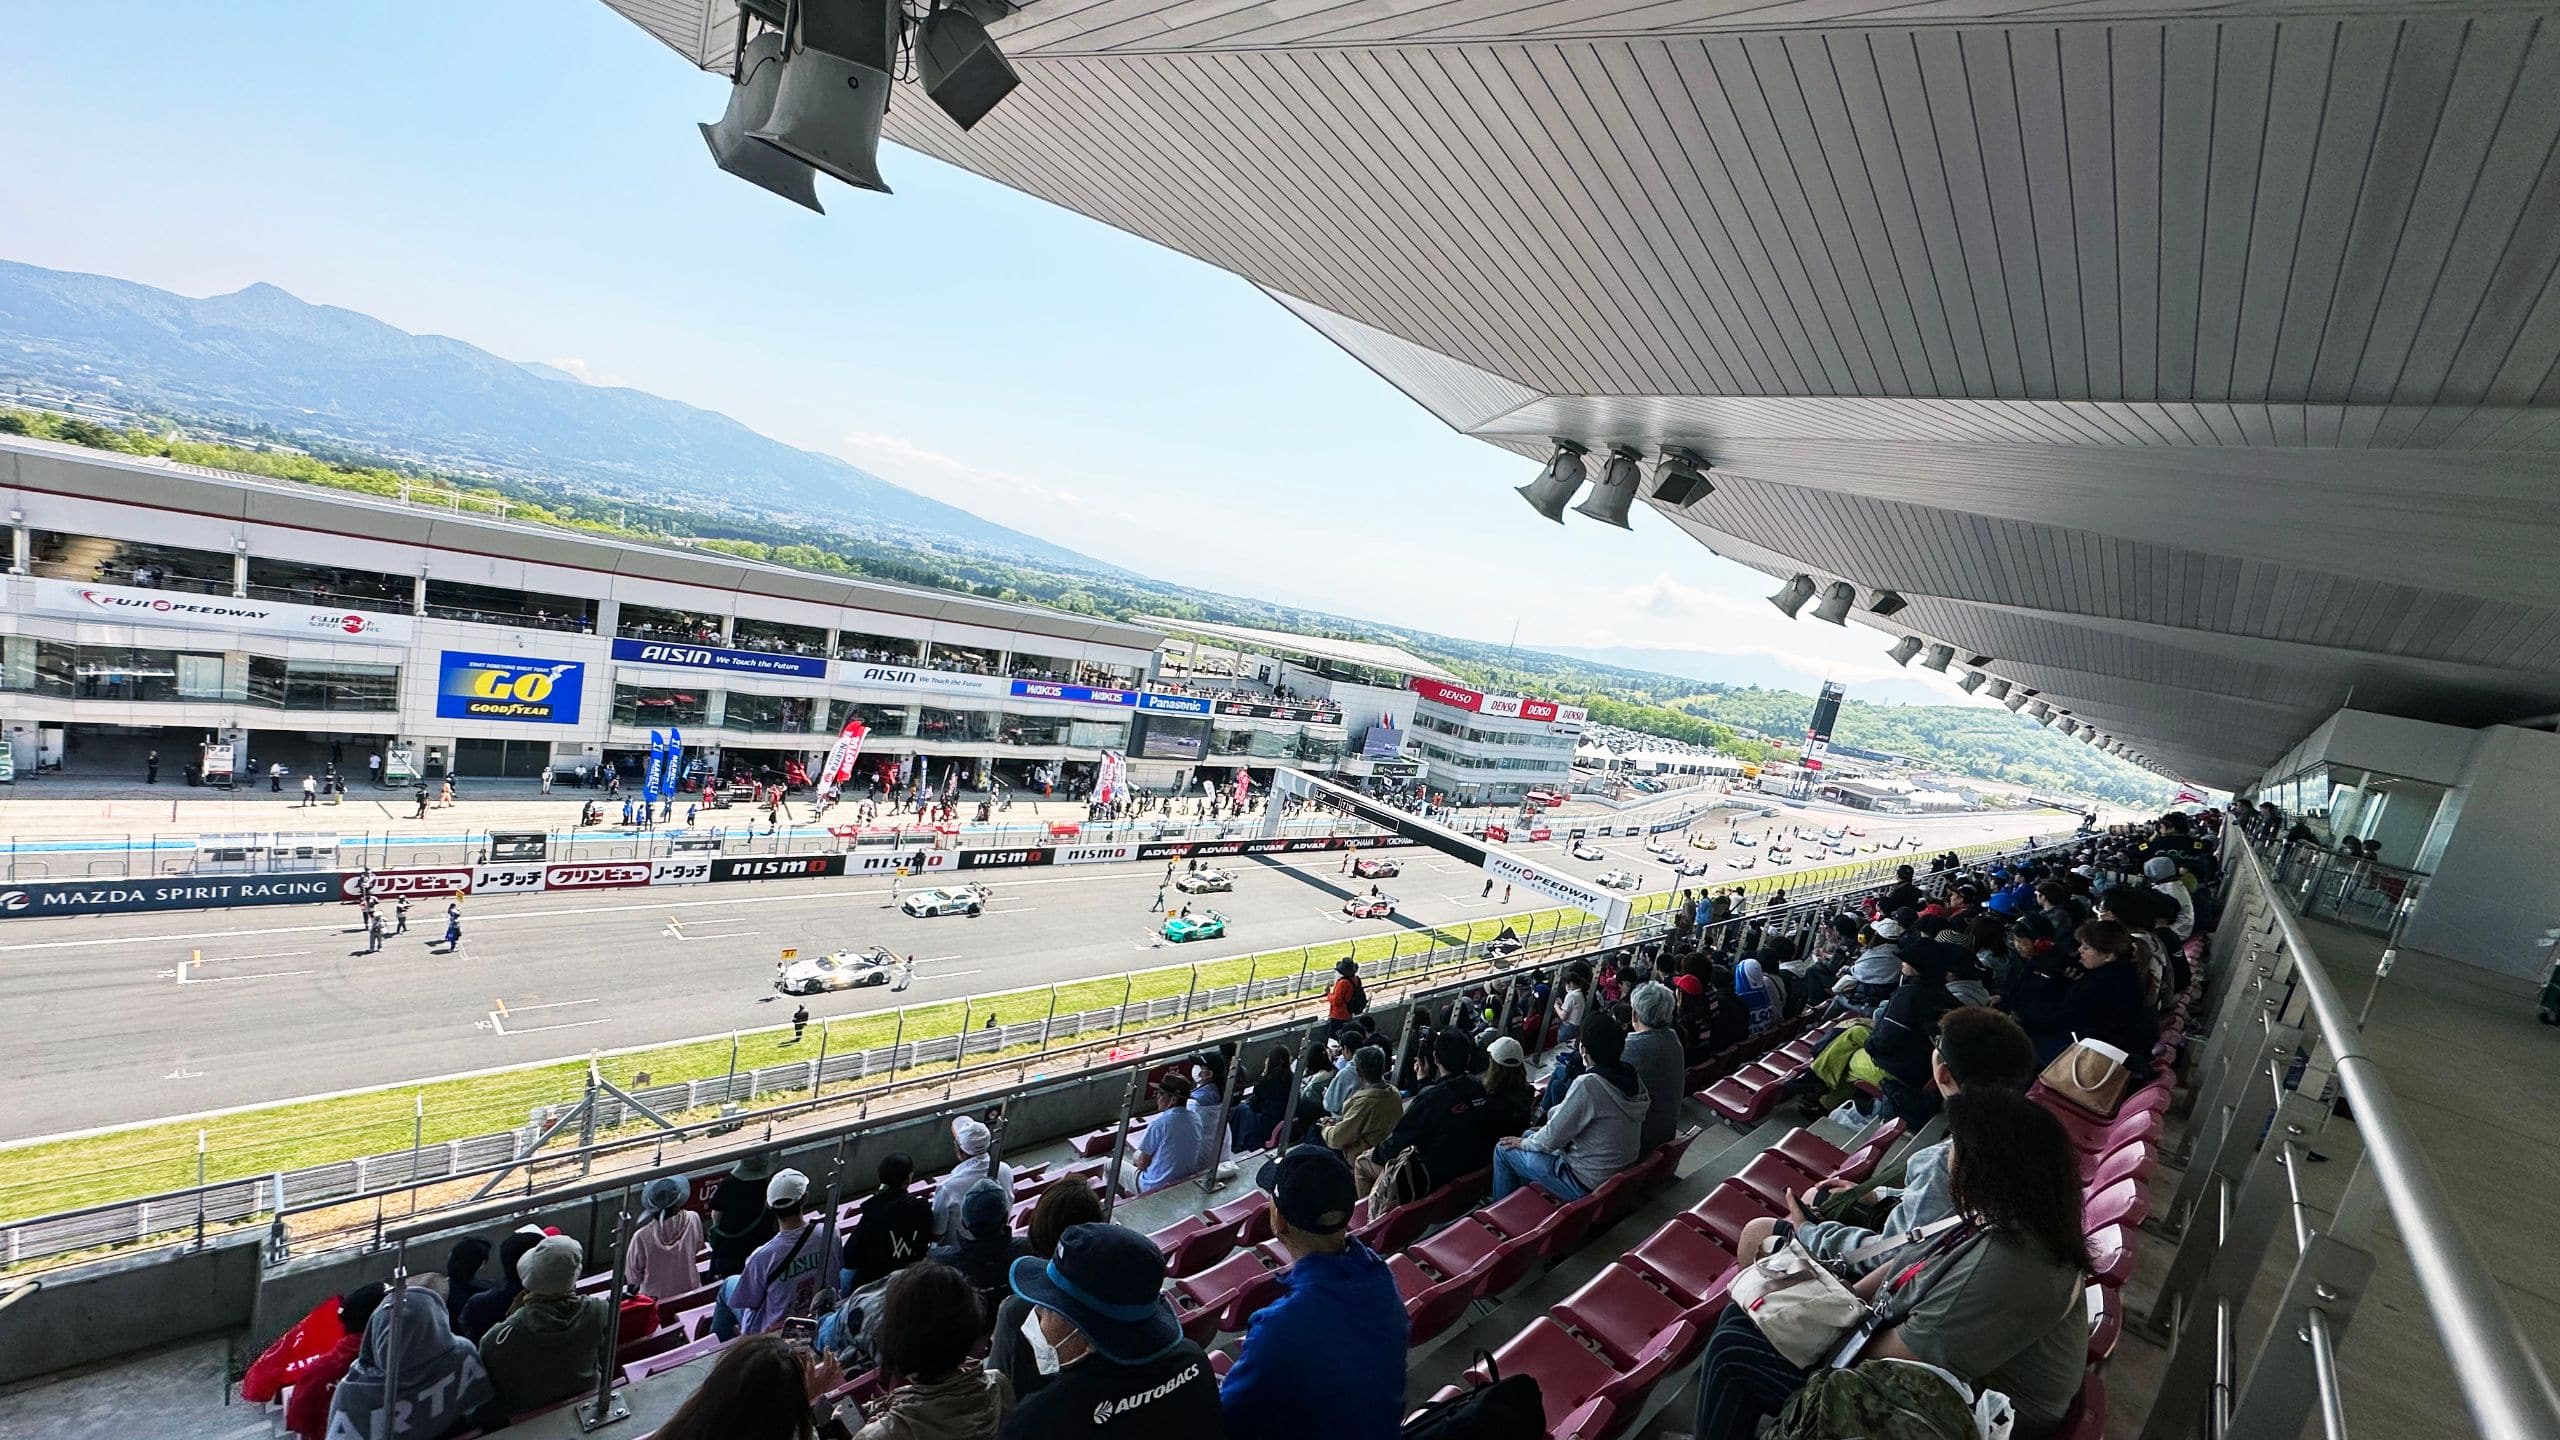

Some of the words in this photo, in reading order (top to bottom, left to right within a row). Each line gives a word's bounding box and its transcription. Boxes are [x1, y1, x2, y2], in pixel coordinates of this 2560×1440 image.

[102, 597, 150, 608] FUJI
[152, 600, 271, 619] SPEEDWAY
[641, 646, 712, 665] AISIN
[715, 655, 730, 664] We
[732, 657, 757, 667] Touch
[758, 659, 772, 668] the
[773, 661, 800, 671] Future
[864, 668, 917, 683] AISIN
[931, 677, 950, 685] Touch
[475, 670, 553, 702] GO
[1149, 696, 1202, 712] Panasonic
[1438, 688, 1473, 704] DENSO
[470, 703, 550, 716] GOODYEAR
[1490, 700, 1517, 713] DENSO
[1526, 704, 1552, 717] DENSO
[1562, 710, 1584, 720] DENSO
[1142, 847, 1188, 857] ADVAN
[1197, 846, 1239, 855] ADVAN
[1247, 844, 1285, 852] ADVAN
[1292, 842, 1327, 850] ADVAN
[476, 871, 542, 888] ノータッチ
[556, 868, 644, 884] クリンビュー
[653, 864, 708, 879] ノータッチ
[1494, 860, 1522, 874] FUJI
[1522, 868, 1599, 903] SPEEDWAY
[43, 889, 146, 906] MAZDA
[155, 885, 231, 901] SPIRIT
[241, 881, 327, 897] RACING
[1114, 1363, 1200, 1414] AUTOBACS
